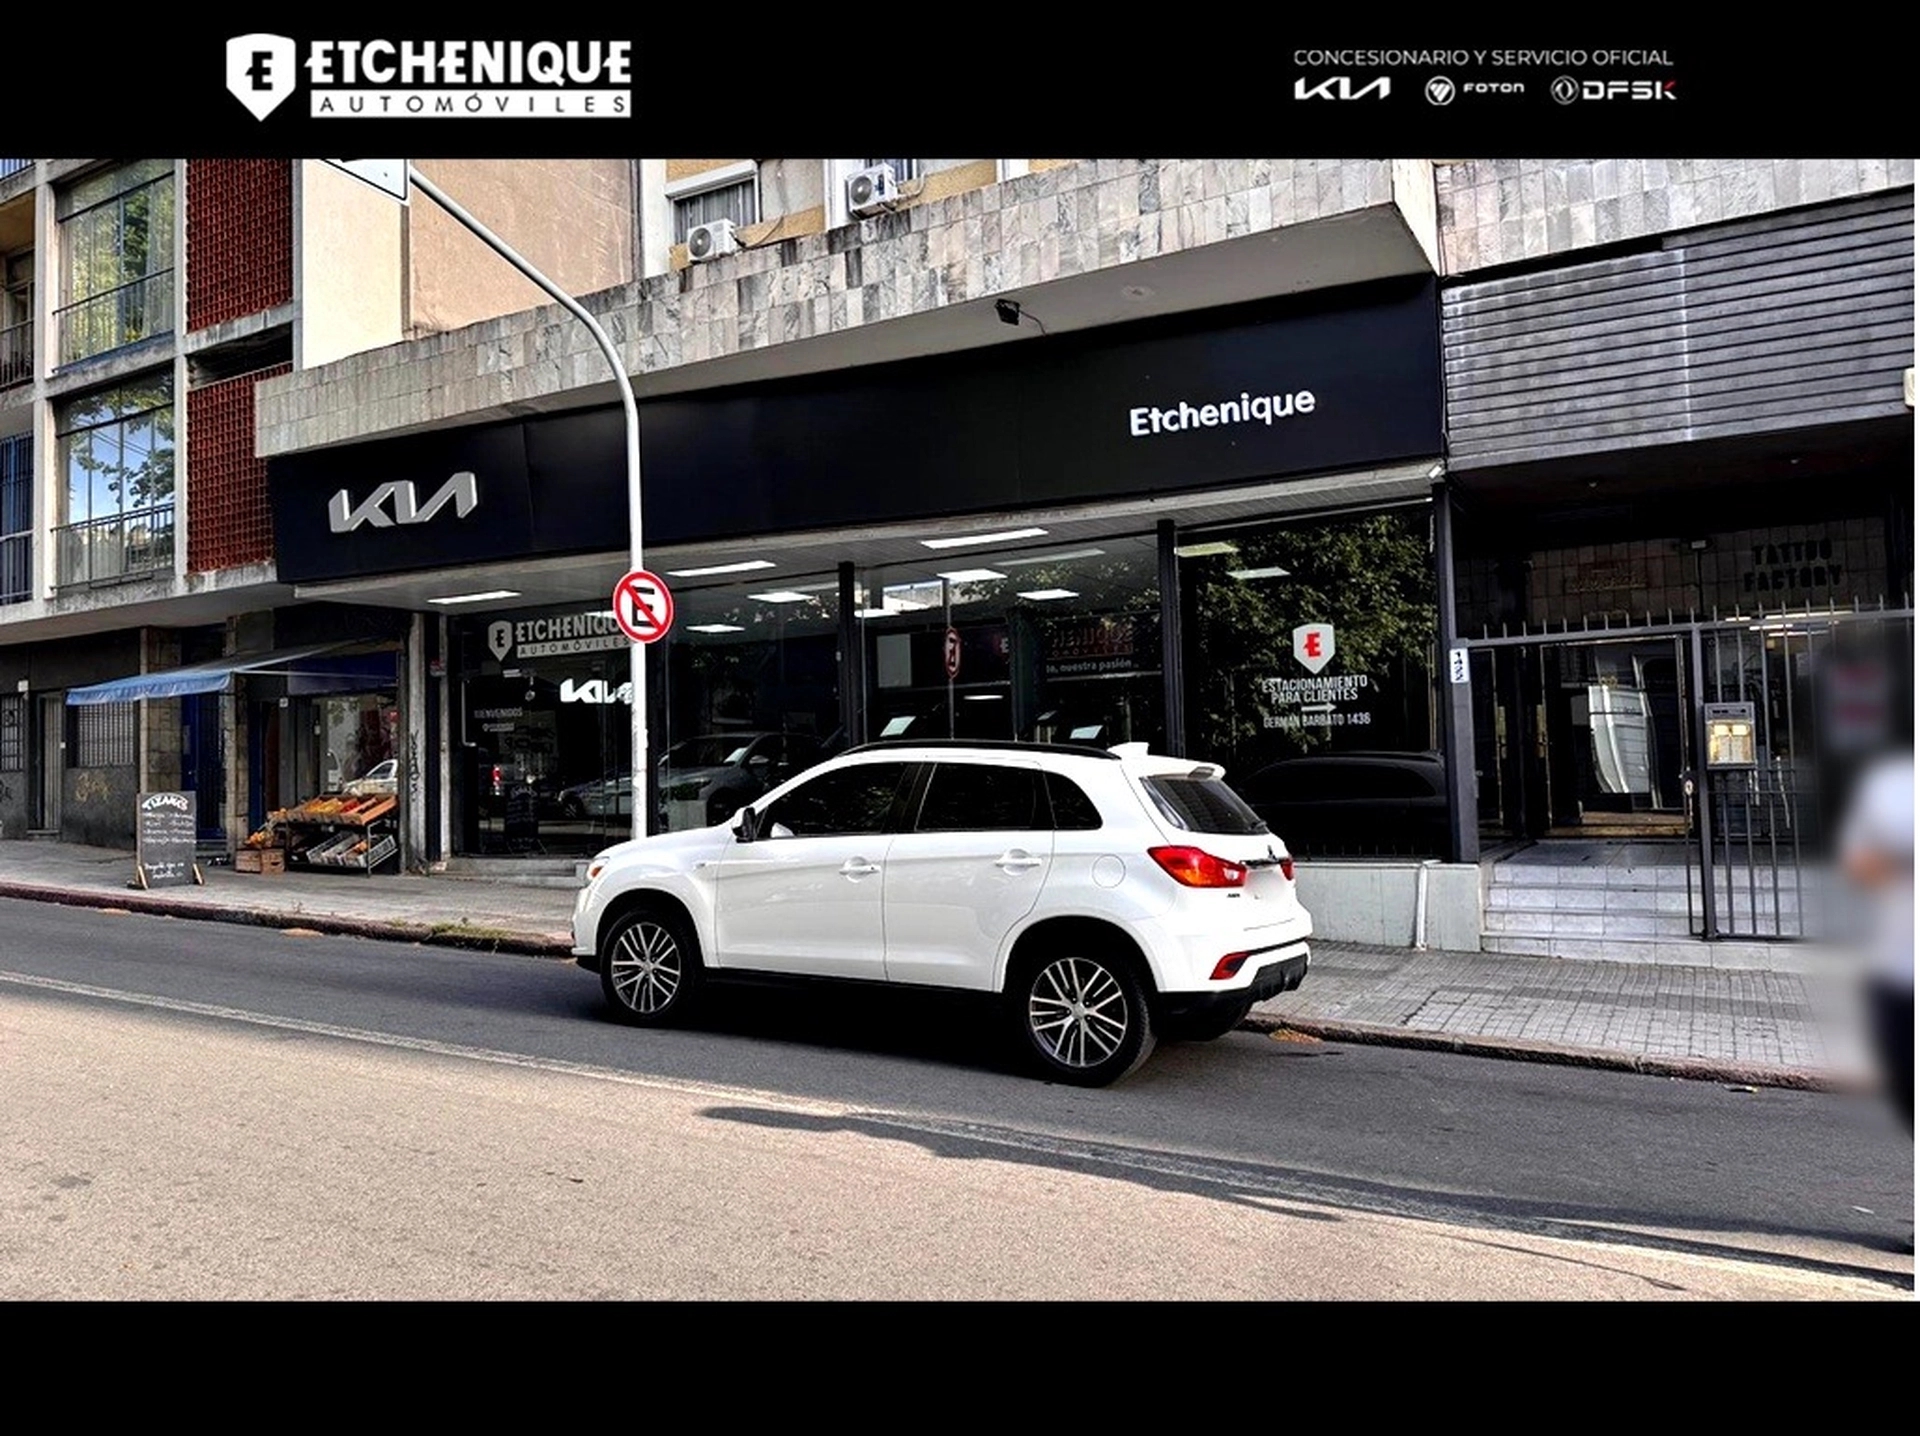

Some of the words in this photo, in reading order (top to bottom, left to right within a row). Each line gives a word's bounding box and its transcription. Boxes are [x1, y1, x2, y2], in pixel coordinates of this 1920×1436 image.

[1130, 390, 1316, 437] Etchenique
[328, 471, 478, 533] KIA
[1743, 564, 1843, 592] FACTORY
[631, 586, 655, 627] E
[515, 613, 620, 643] ETCHENIQU
[1262, 674, 1368, 693] ESTACIONAMIENTO
[1271, 691, 1301, 704] PARA
[1304, 688, 1359, 703] CLIENTES
